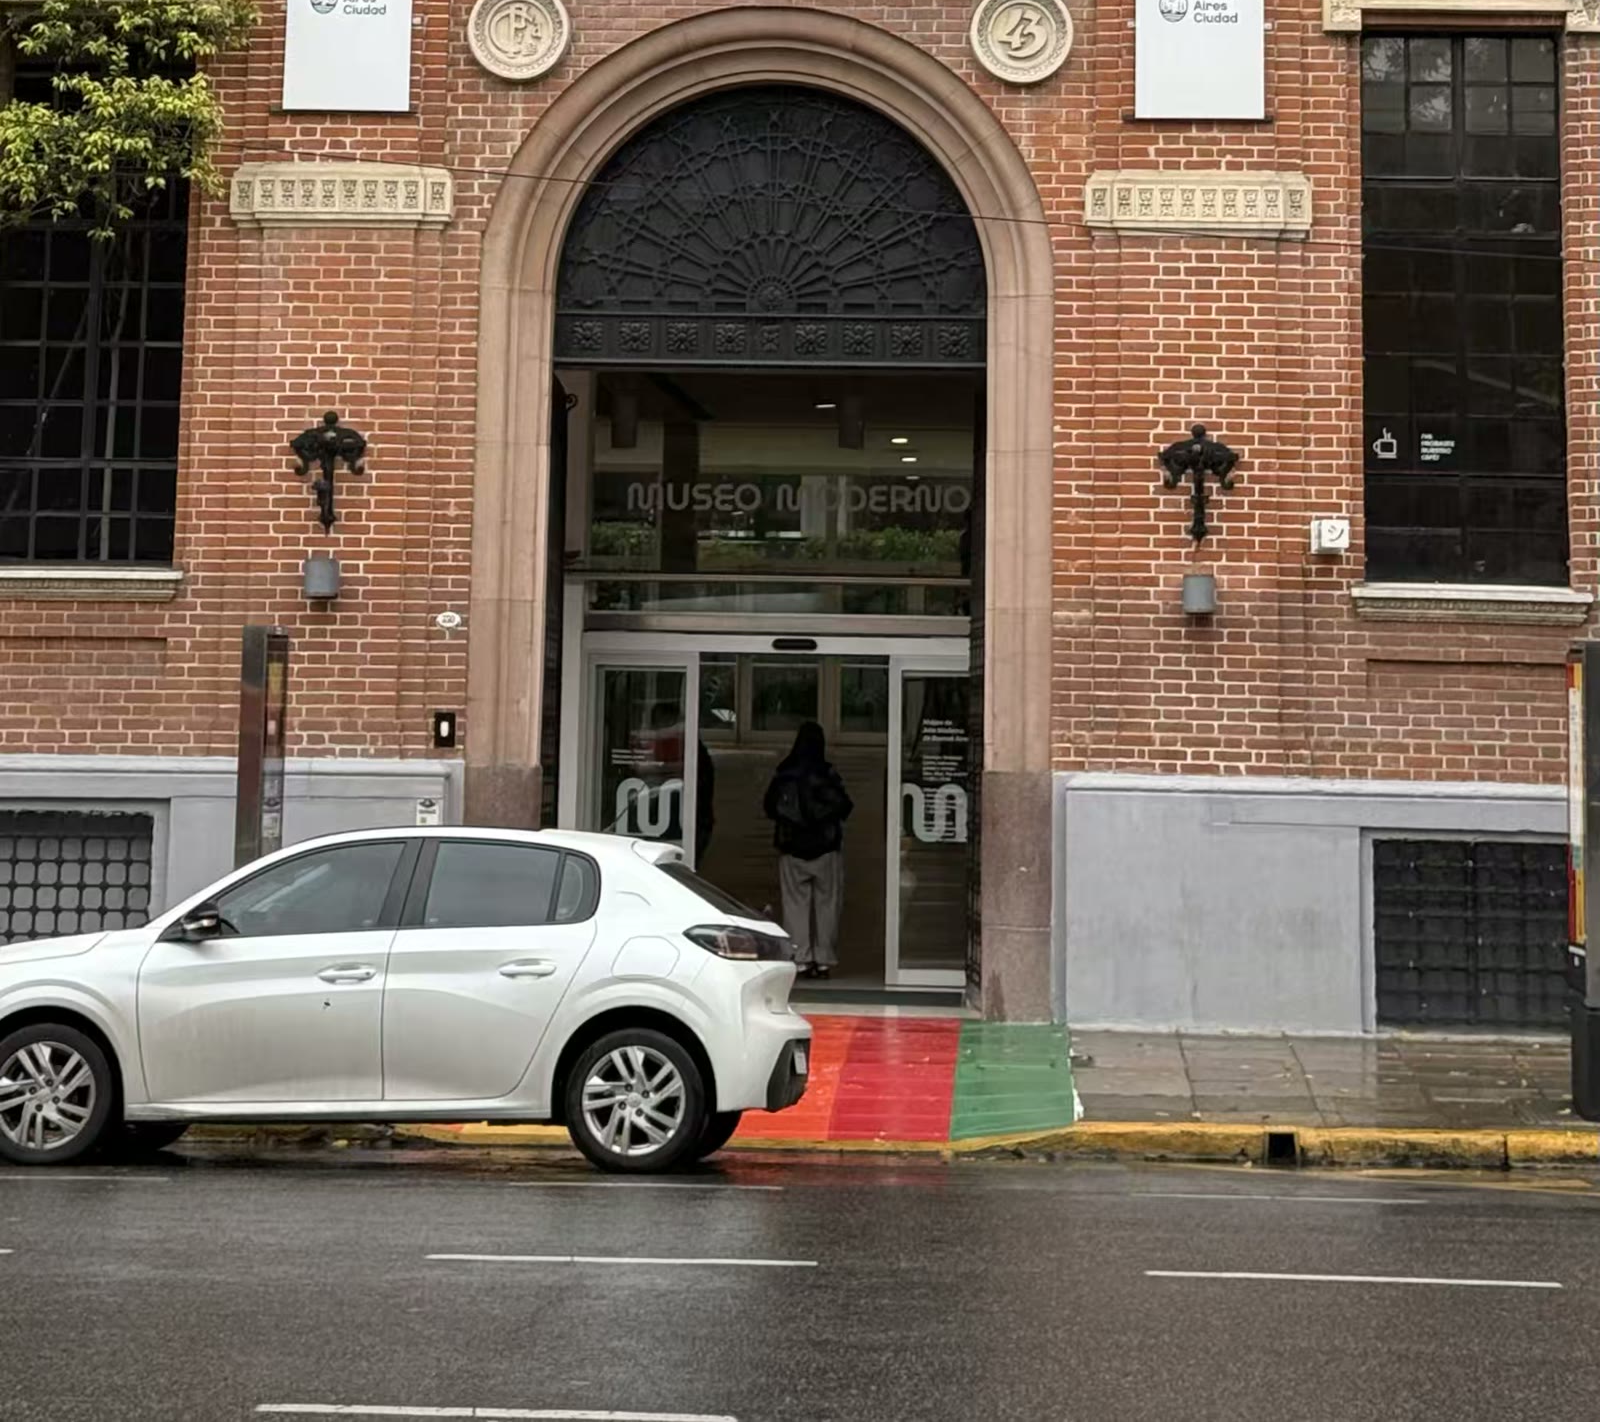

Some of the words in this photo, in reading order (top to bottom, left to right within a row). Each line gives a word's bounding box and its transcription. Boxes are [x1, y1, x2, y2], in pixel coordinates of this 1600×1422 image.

[343, 4, 387, 15] Ciudad
[1193, 0, 1228, 11] Aires
[1193, 12, 1238, 23] Ciudad
[627, 482, 762, 511] MUSEO
